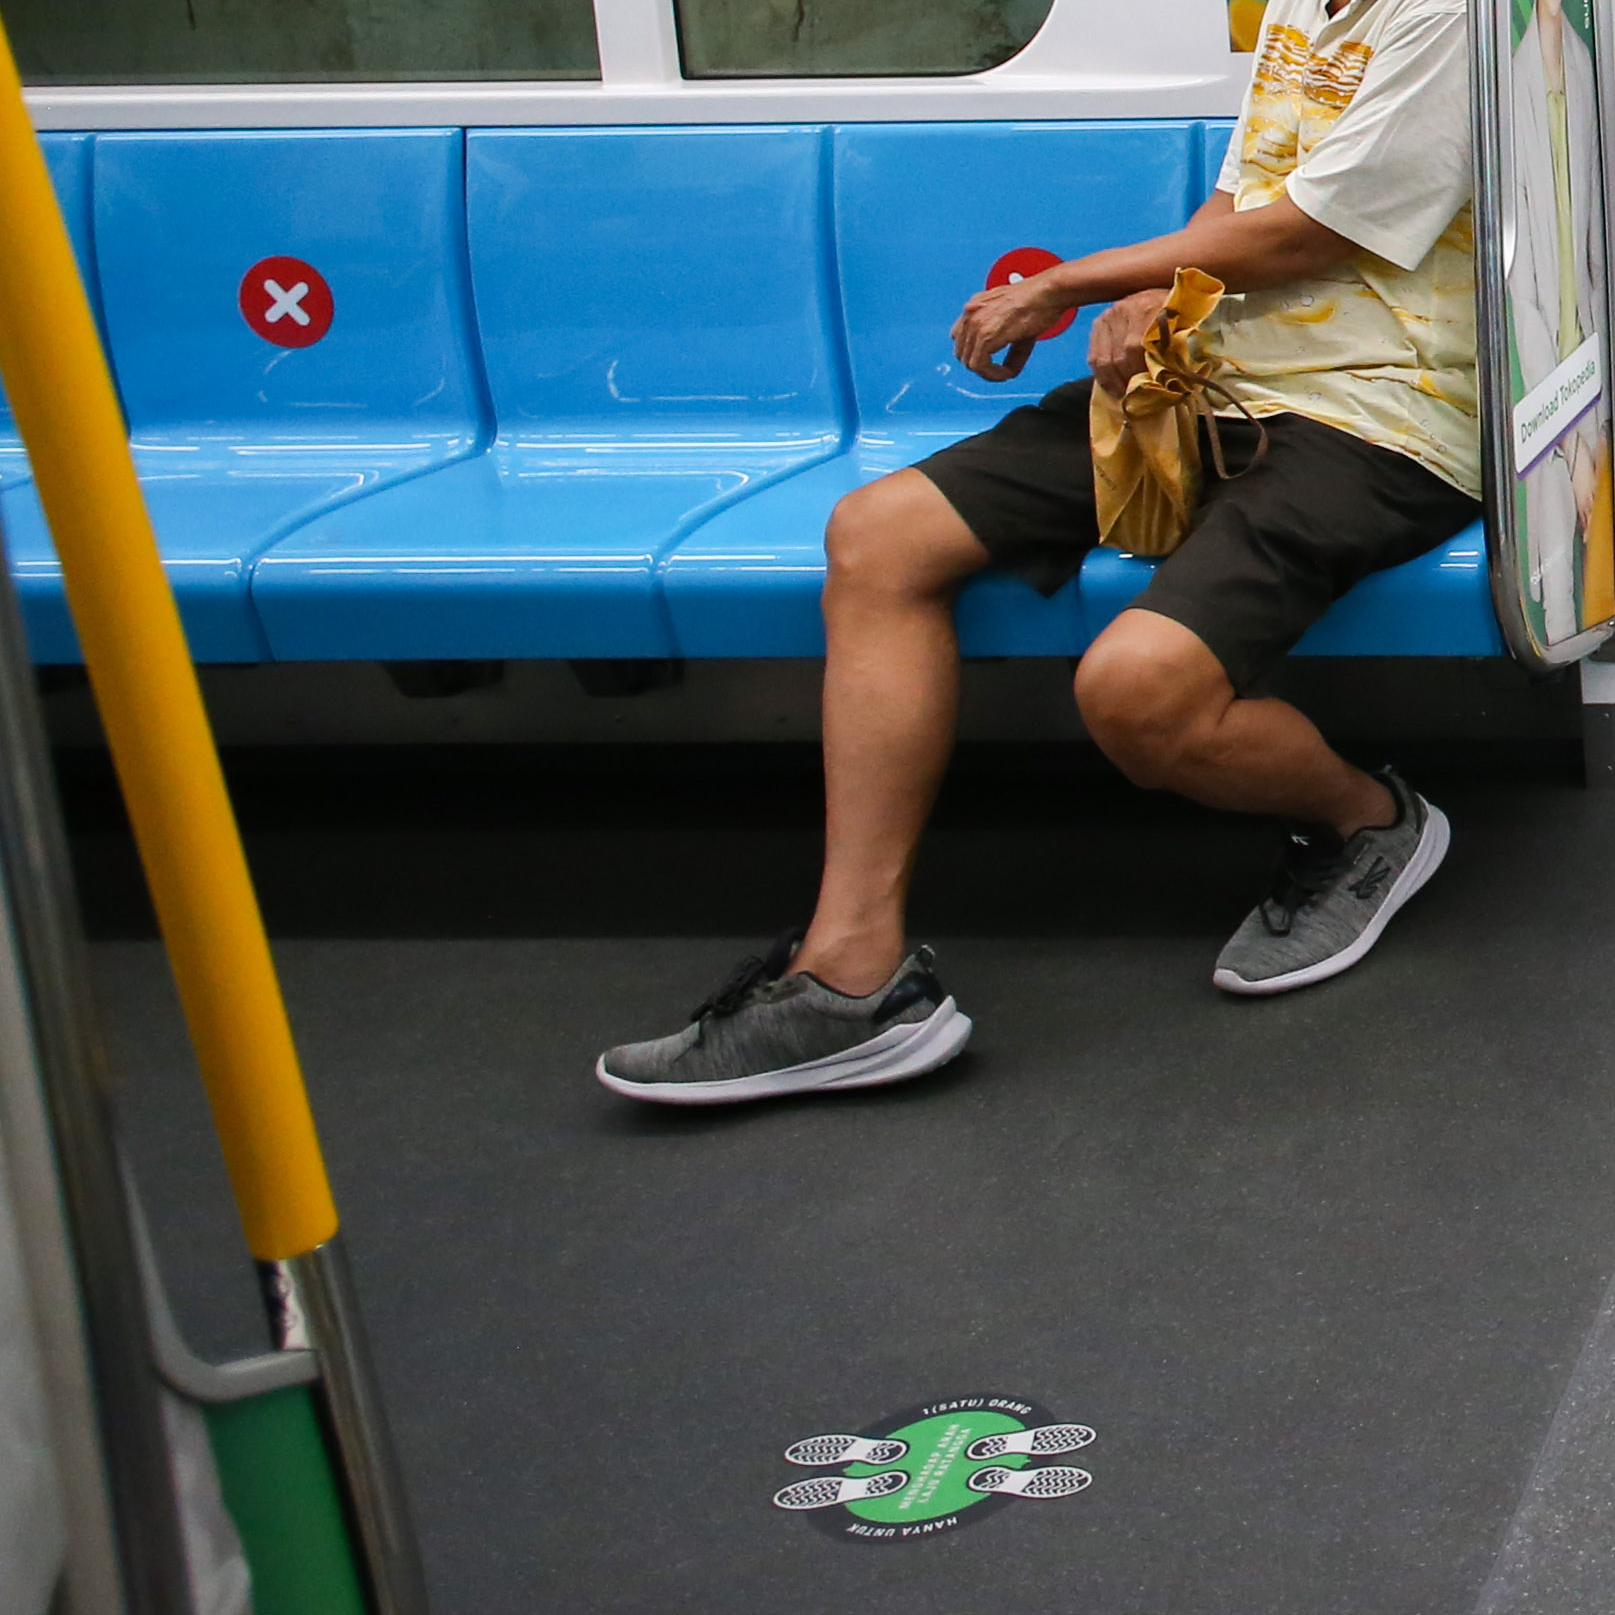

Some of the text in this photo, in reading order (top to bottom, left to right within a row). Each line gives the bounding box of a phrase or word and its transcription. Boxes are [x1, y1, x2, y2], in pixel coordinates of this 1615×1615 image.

[1520, 358, 1597, 444] Download Tokopedia
[988, 1398, 1033, 1416] ORANG
[846, 1516, 958, 1538] HANYA UNTUK
